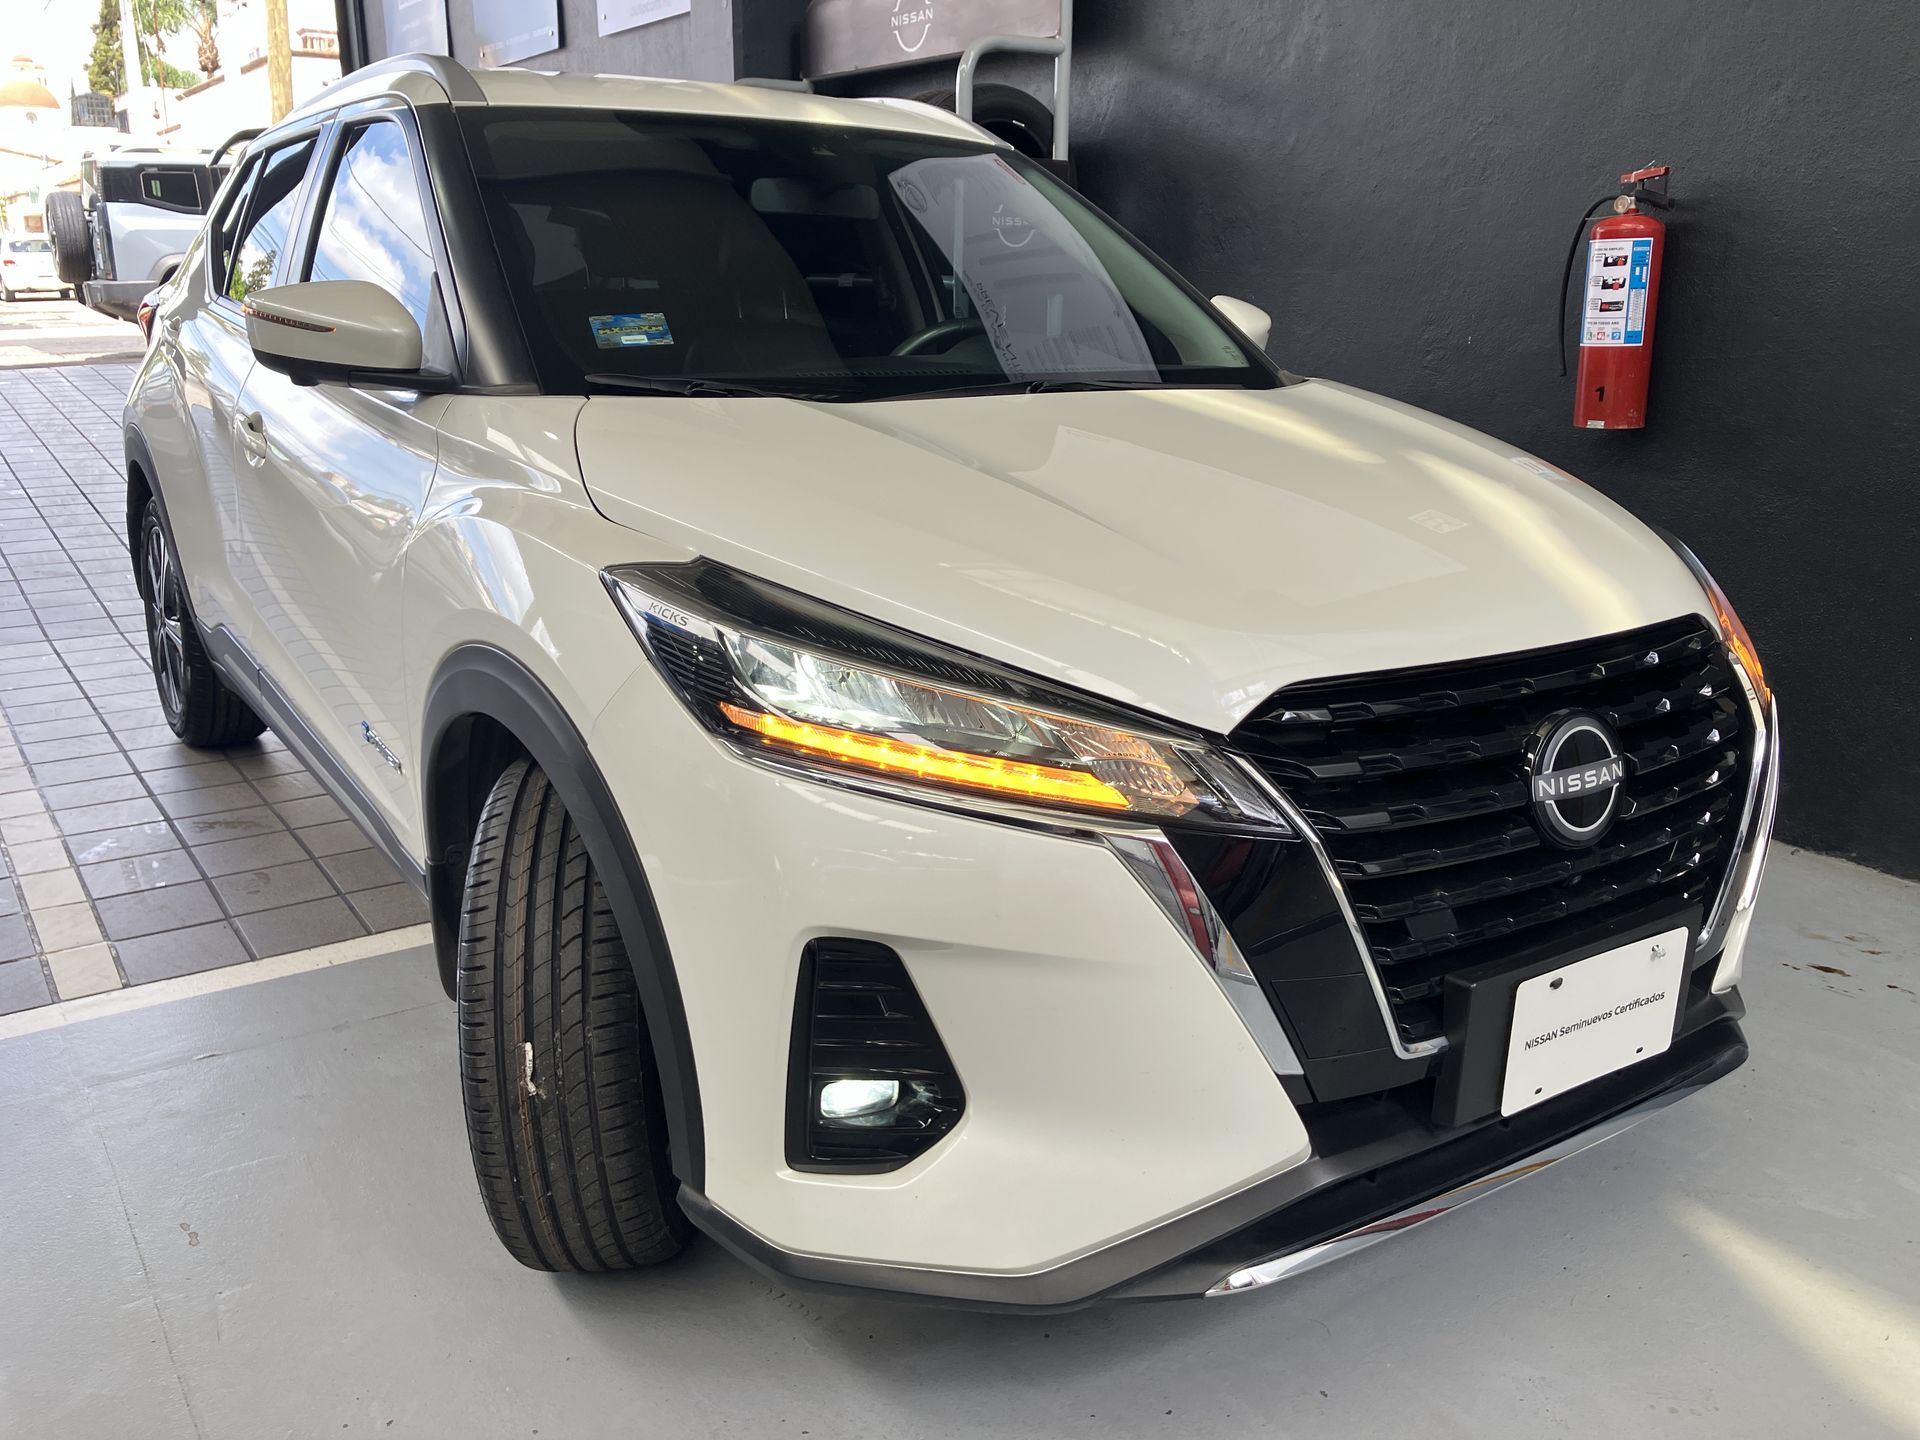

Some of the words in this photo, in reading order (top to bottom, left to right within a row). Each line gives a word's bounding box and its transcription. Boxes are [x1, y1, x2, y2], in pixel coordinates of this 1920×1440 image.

[890, 7, 934, 27] NISSAN
[1594, 385, 1606, 403] 1
[648, 602, 689, 627] KICKS
[1538, 760, 1622, 797] NISSAN
[1524, 1030, 1558, 1050] NISSAN
[1559, 1010, 1612, 1036] Seminuevos
[1614, 992, 1665, 1015] Certificados
